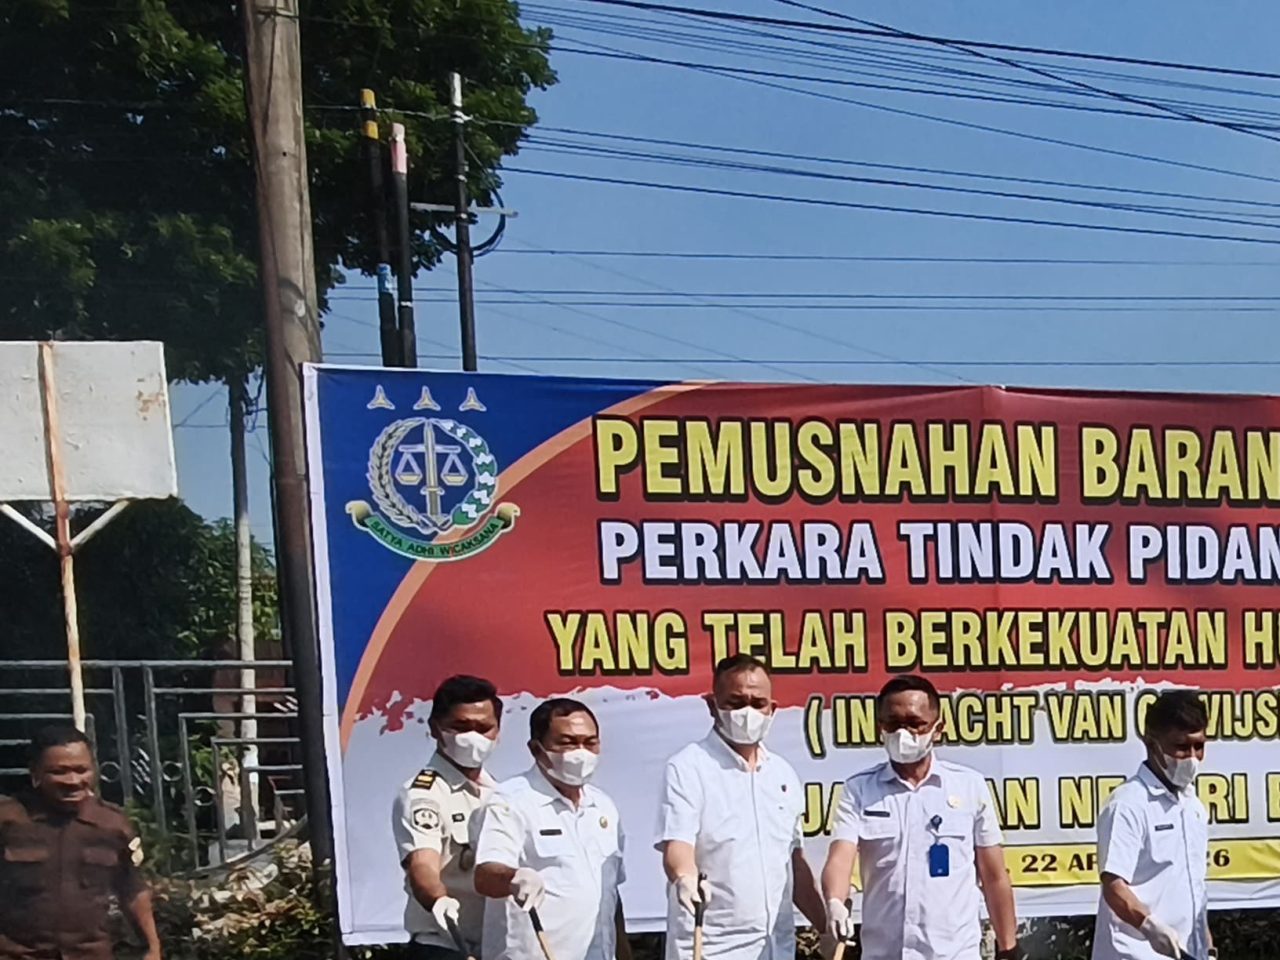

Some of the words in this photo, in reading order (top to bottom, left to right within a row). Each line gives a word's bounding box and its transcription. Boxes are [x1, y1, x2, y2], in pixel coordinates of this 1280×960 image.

[594, 417, 1059, 500] PEMUSNAHAN
[371, 520, 403, 548] SATYA
[407, 543, 434, 556] ADHI
[439, 522, 499, 556] WICAKSANA
[600, 520, 885, 582] PERKARA
[899, 521, 1112, 582] TINDAK
[546, 611, 688, 671] YANG
[703, 611, 867, 669] TELAH
[884, 610, 1227, 668] BERKEKUATAN
[1047, 693, 1123, 740] VAN
[1022, 854, 1057, 873] 22
